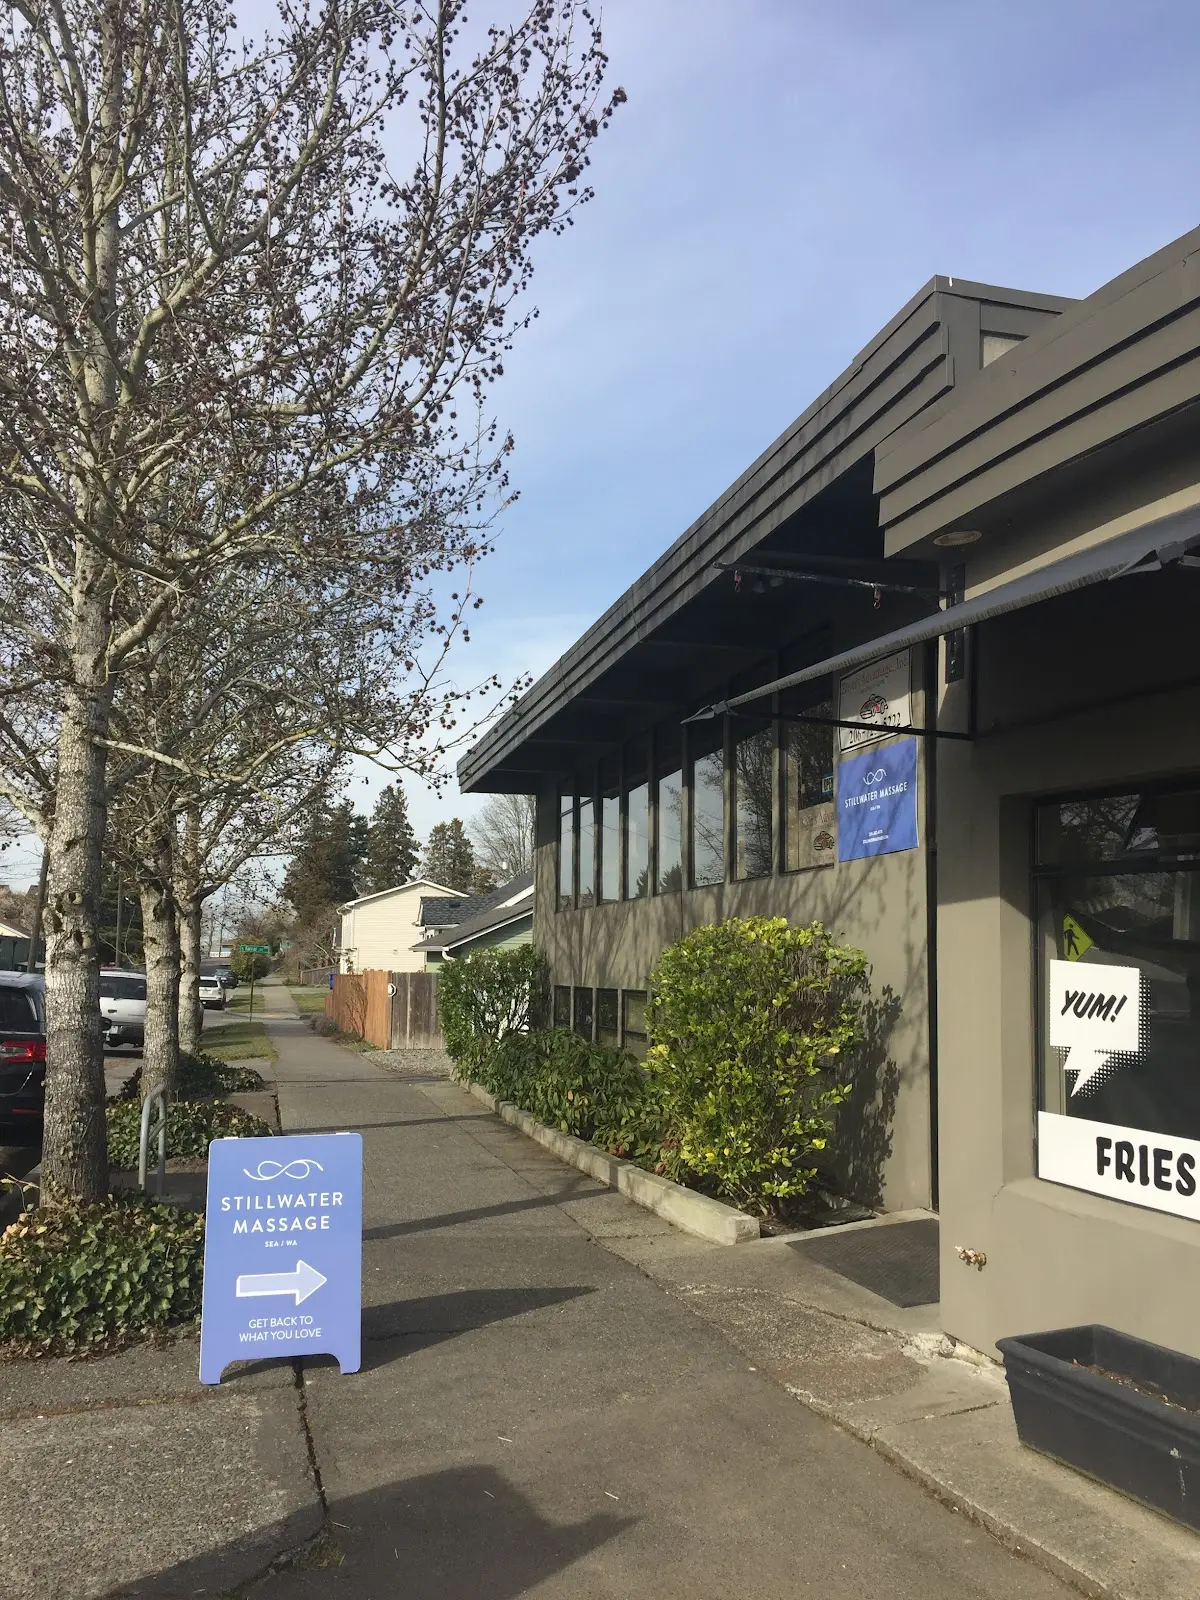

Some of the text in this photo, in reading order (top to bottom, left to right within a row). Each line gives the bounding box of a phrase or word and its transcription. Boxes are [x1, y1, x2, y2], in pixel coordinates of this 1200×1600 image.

[844, 781, 908, 808] STILLWATER MASSAGE
[1060, 989, 1128, 1023] YUM!
[1096, 1136, 1197, 1197] FRIES
[221, 1191, 343, 1212] STILLWATER
[232, 1215, 330, 1235] MASSAGE
[264, 1240, 279, 1248] SEA
[248, 1315, 314, 1329] GET BACK TO
[239, 1327, 322, 1342] WHAT YOU LOVE
